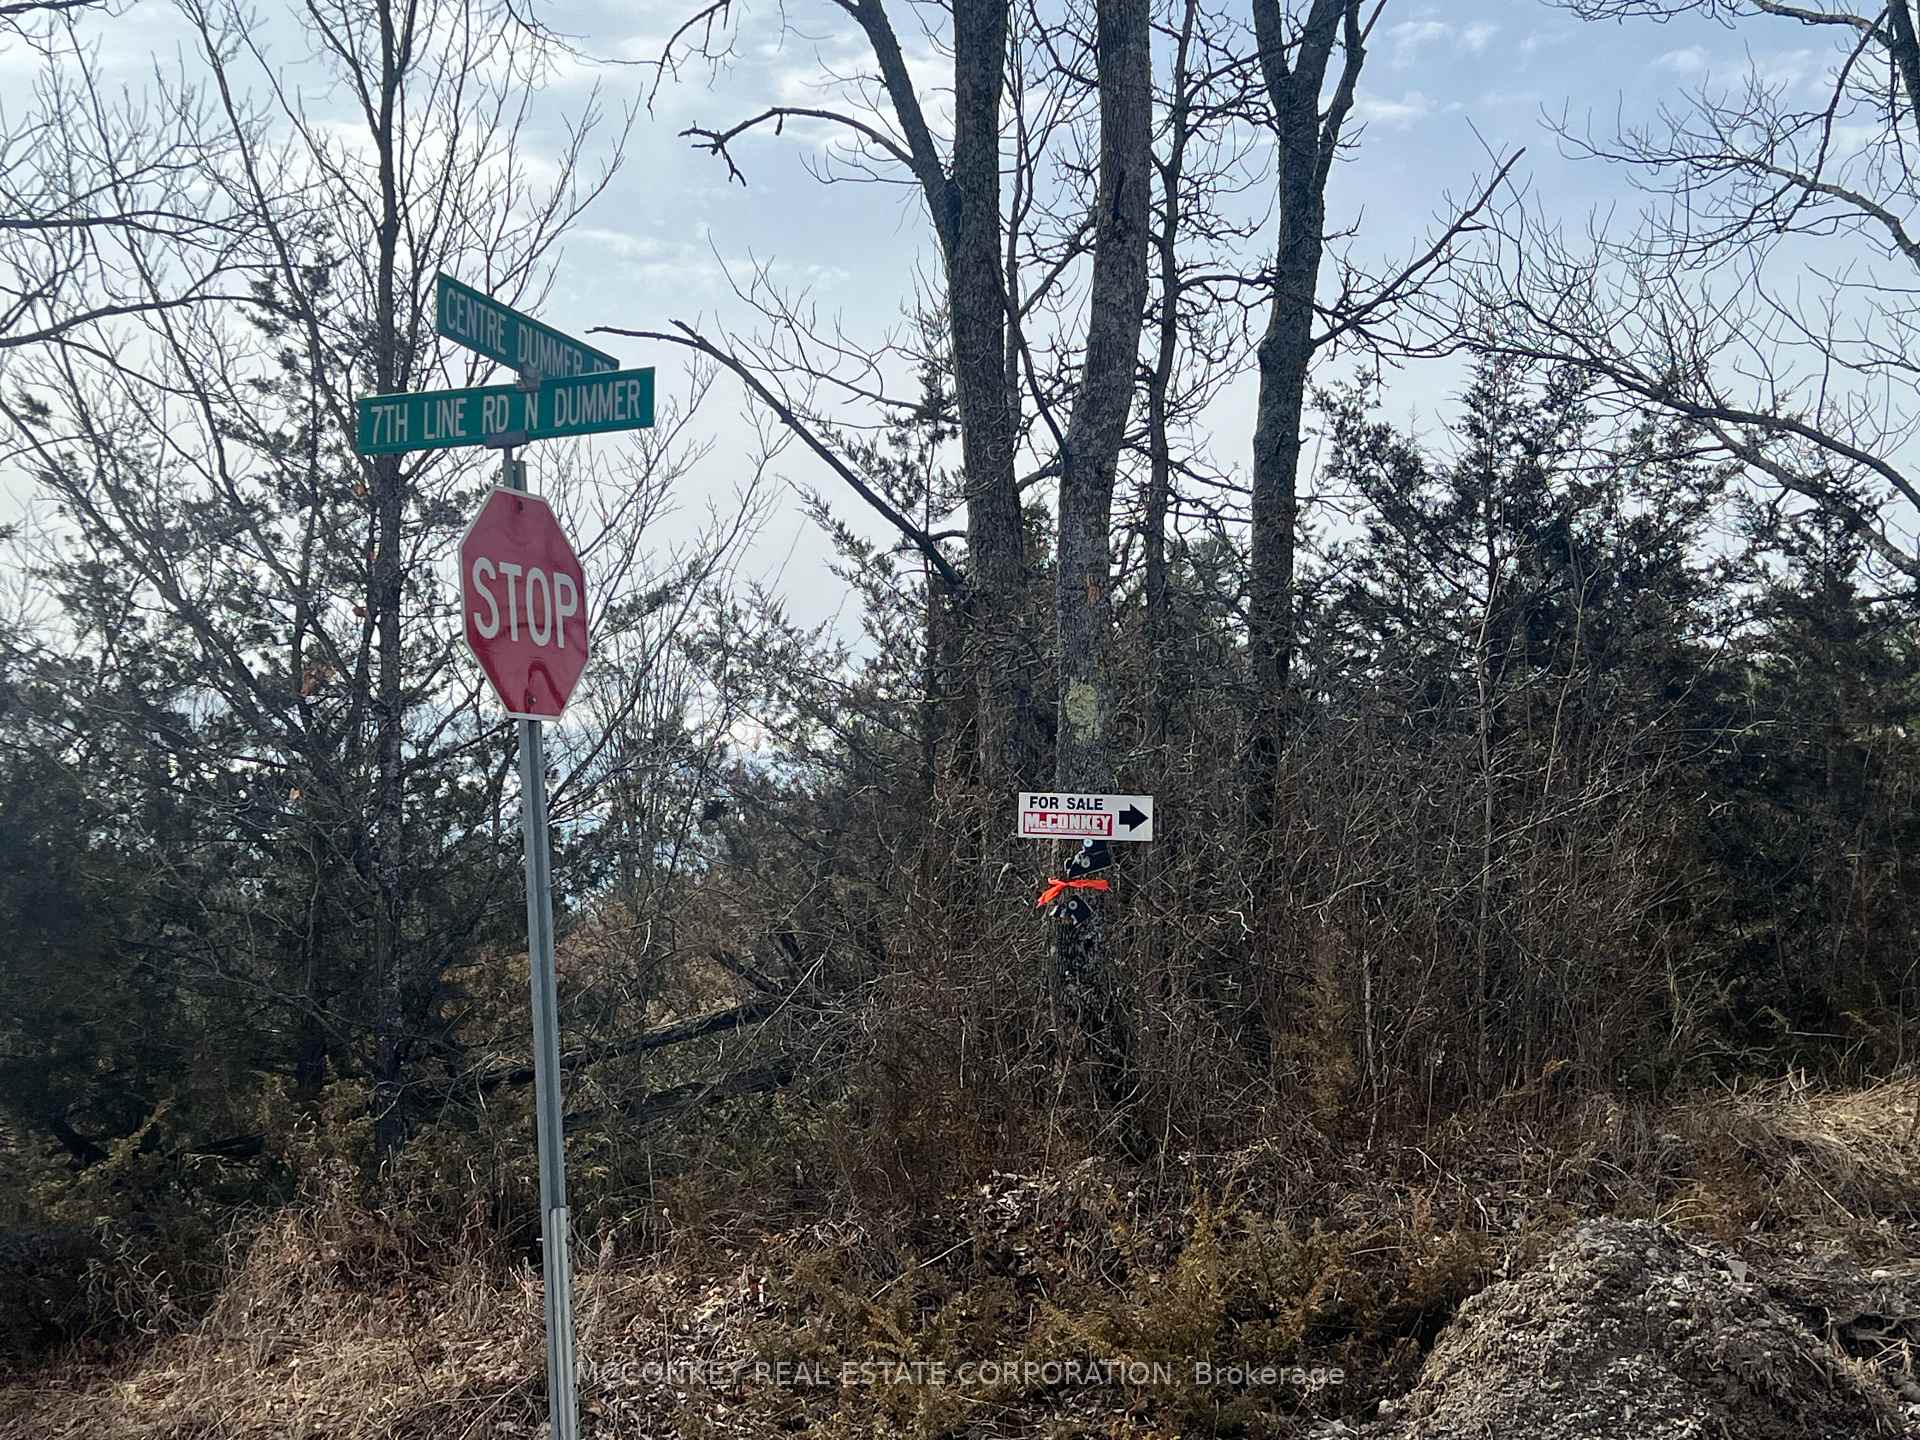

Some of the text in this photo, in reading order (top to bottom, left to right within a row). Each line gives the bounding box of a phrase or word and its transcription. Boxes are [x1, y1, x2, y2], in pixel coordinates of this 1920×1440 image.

[445, 287, 583, 377] CENTRE DUMMER
[370, 379, 641, 445] 7TH LINE RD N DUMMER
[472, 556, 578, 649] STOP
[1029, 796, 1104, 810] FOR SALE
